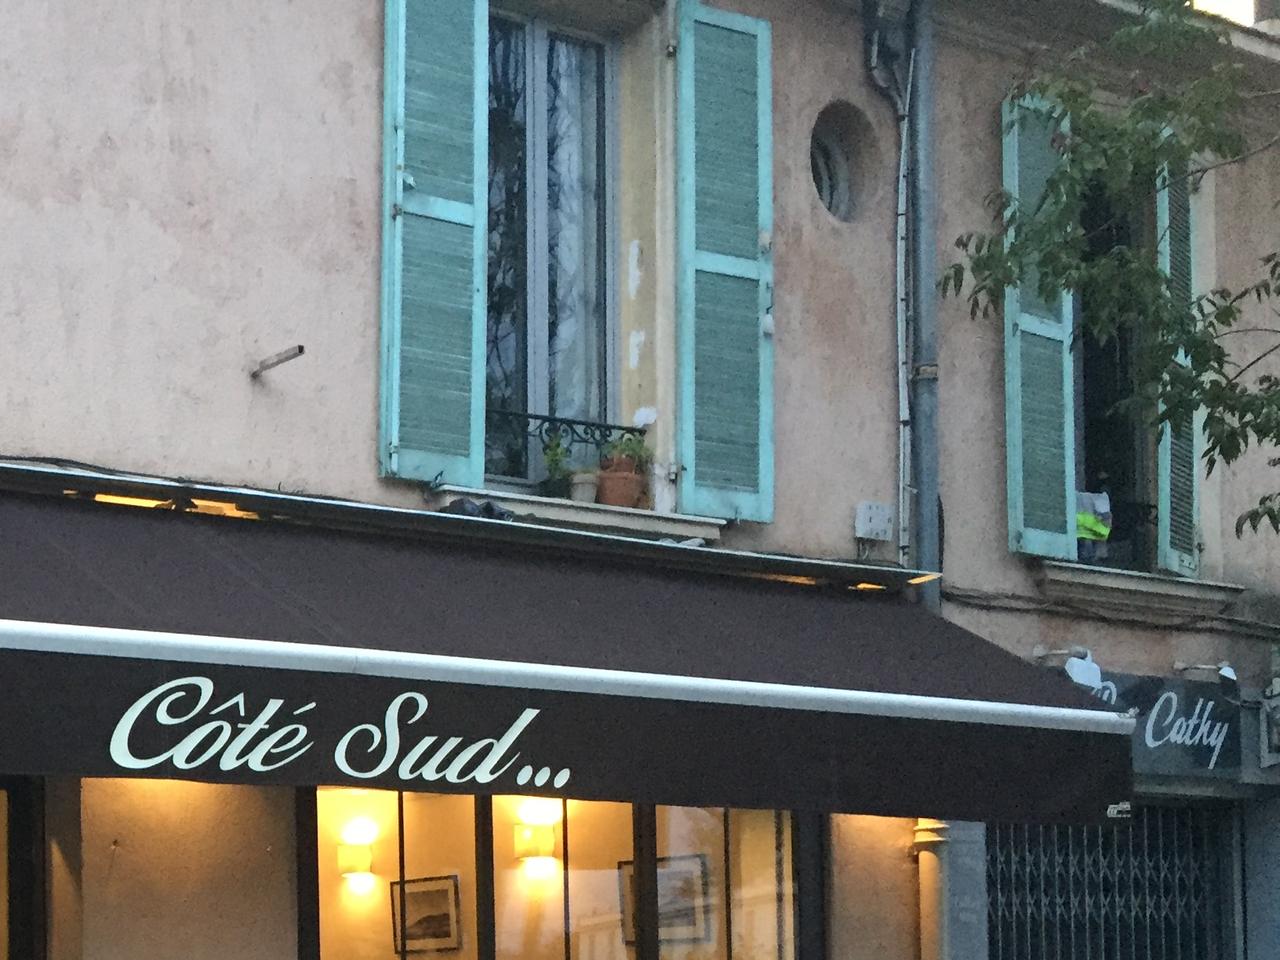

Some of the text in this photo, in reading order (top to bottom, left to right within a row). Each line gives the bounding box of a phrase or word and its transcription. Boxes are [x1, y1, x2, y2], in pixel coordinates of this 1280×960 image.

[109, 676, 571, 788] Côté Sud...
[1144, 691, 1229, 770] Cathy
